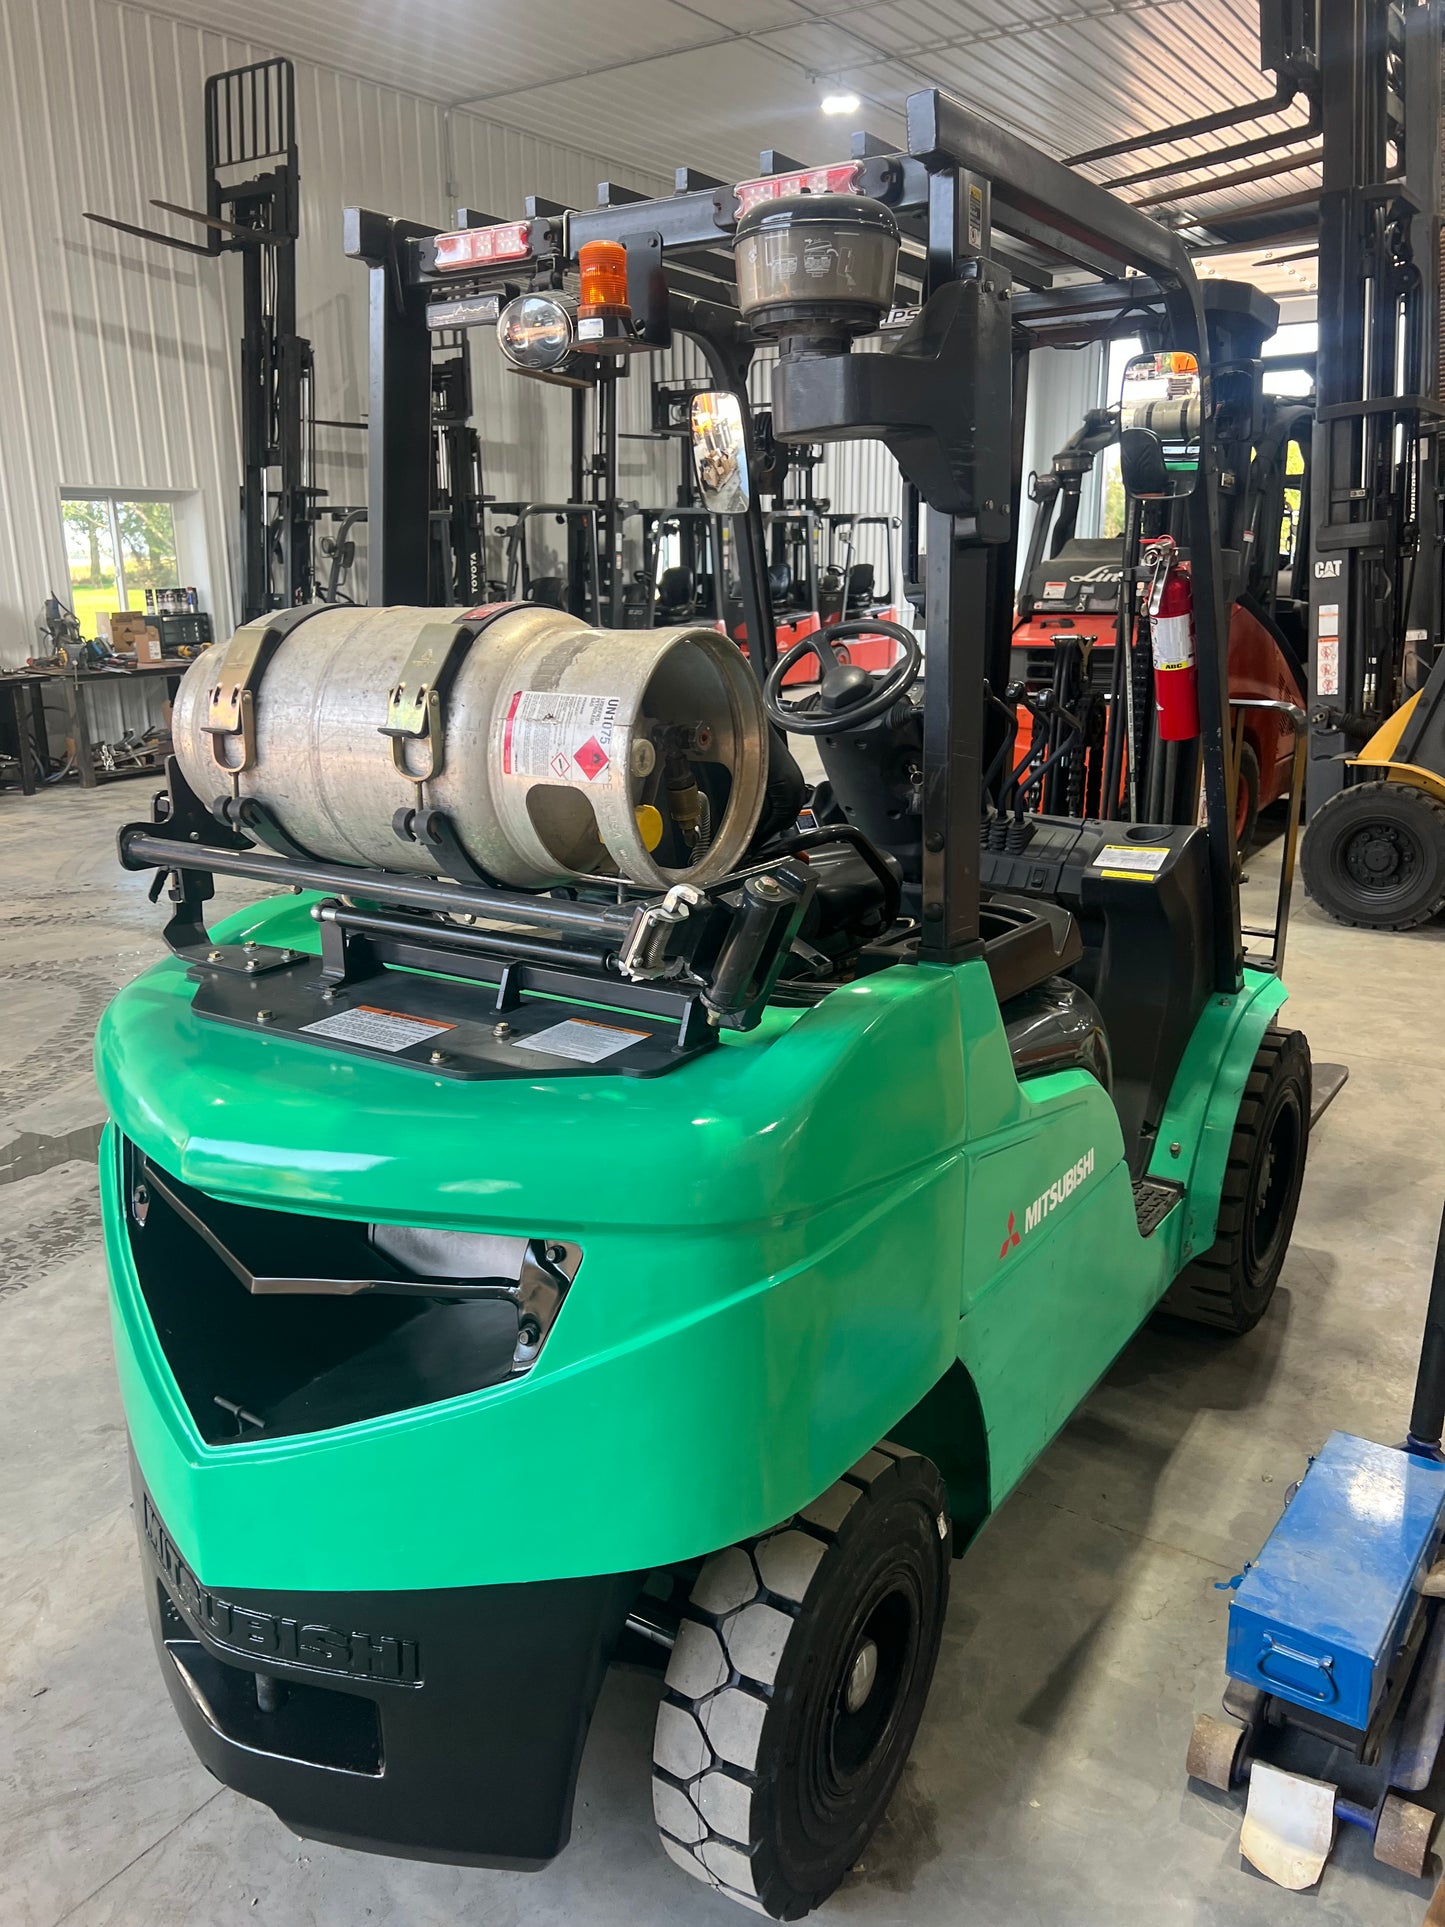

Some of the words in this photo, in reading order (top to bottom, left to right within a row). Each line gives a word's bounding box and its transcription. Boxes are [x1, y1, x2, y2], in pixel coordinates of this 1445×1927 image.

[470, 552, 478, 594] TOYOTA
[1314, 560, 1343, 579] CAT
[599, 699, 620, 745] UN1075
[1024, 1147, 1095, 1234] MITSUBISHI
[144, 1493, 420, 1682] MITSUBISHI
